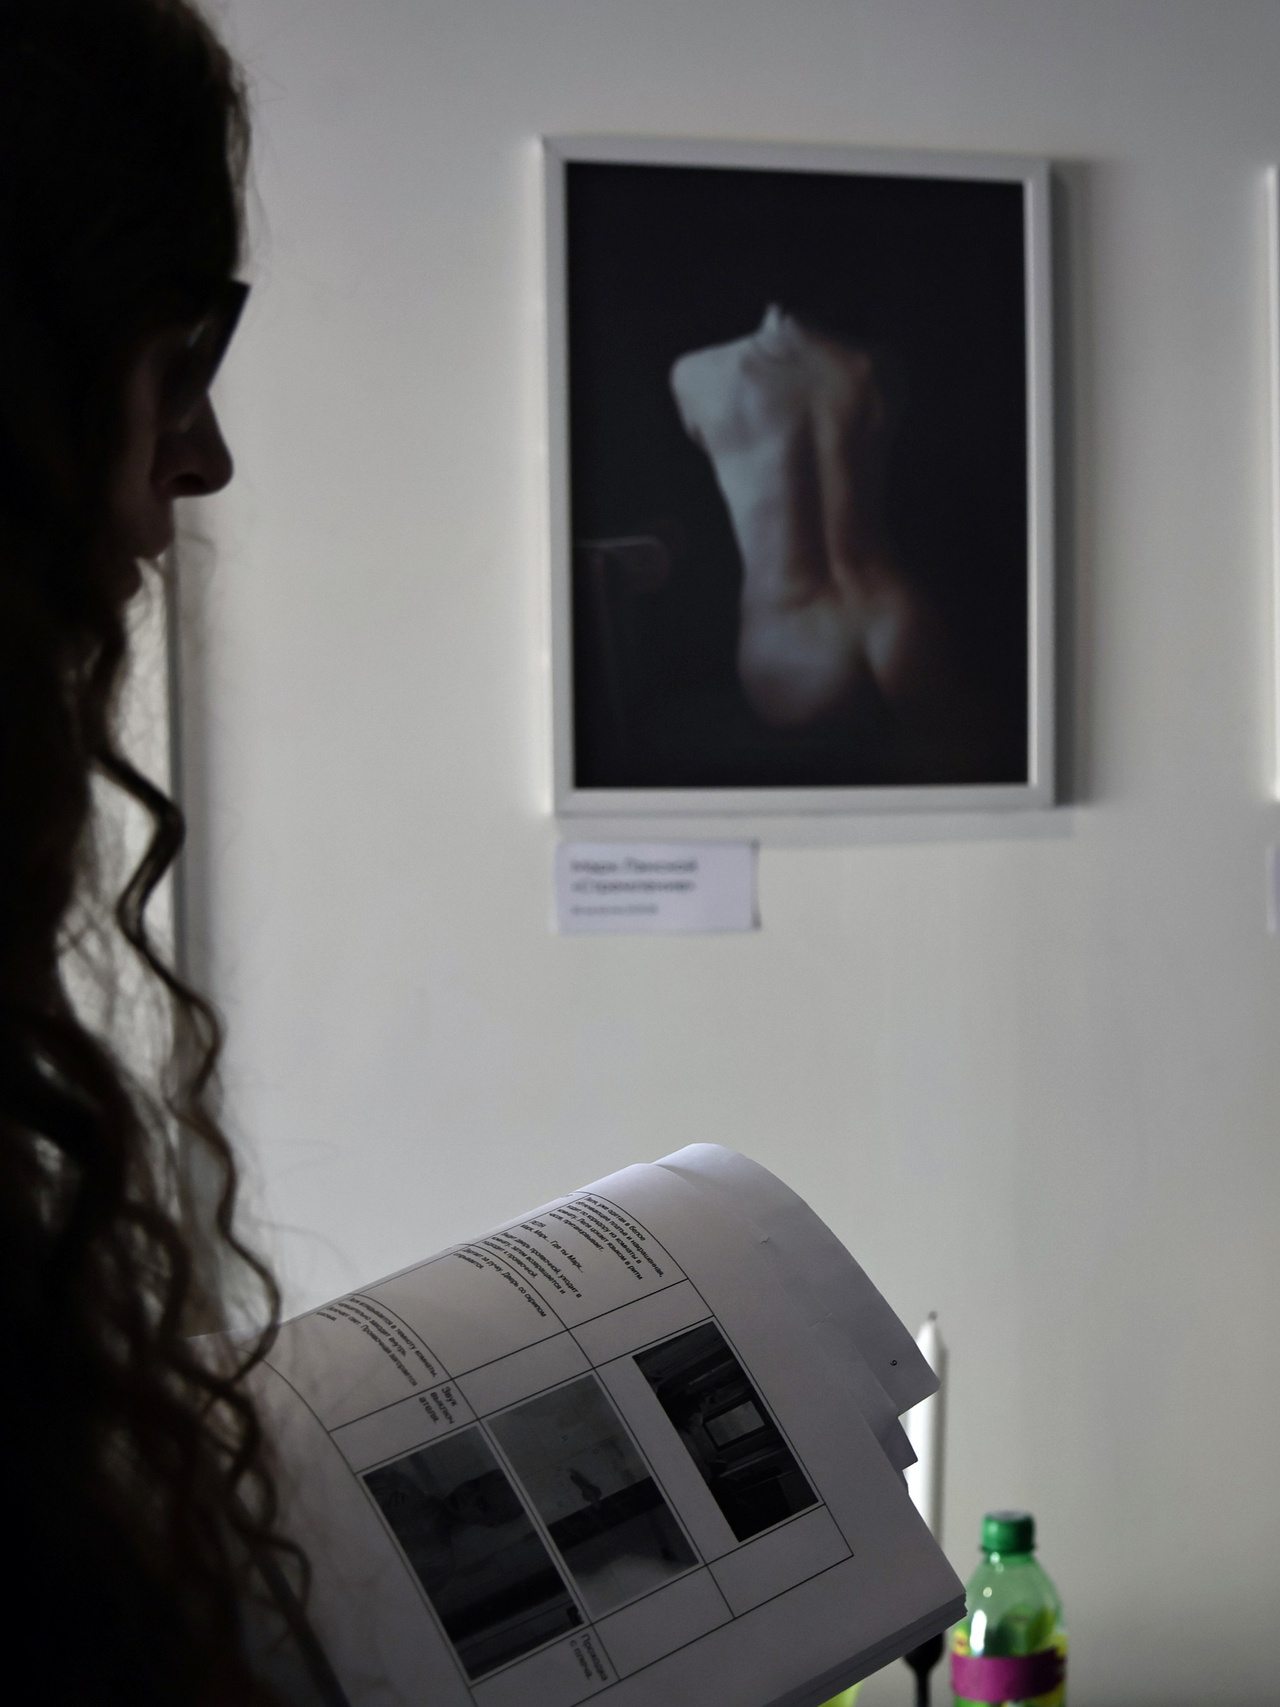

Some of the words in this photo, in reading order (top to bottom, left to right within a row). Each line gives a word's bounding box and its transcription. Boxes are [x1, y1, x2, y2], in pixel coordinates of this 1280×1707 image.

[563, 1219, 604, 1252] пританцовывает.
[587, 1215, 610, 1232] коридору
[615, 1238, 638, 1260] комнаты
[608, 1210, 626, 1223] одетая
[629, 1226, 646, 1241] белое
[550, 1240, 561, 1249] Где
[567, 1254, 584, 1273] Марк...
[590, 1228, 609, 1242] цокает
[607, 1242, 627, 1261] языком
[627, 1265, 643, 1280] ритм
[609, 1220, 628, 1237] платье
[630, 1240, 664, 1278] накрашенная,
[525, 1256, 561, 1290] возвращается
[558, 1274, 579, 1293] уходит
[501, 1271, 519, 1287] Дверь
[518, 1286, 527, 1294] со
[525, 1293, 547, 1318] скрипом
[390, 1353, 418, 1386] загорается
[395, 1328, 418, 1350] темноту
[415, 1350, 438, 1378] комнаты.
[419, 1396, 440, 1424] ателя.
[430, 1391, 455, 1425] выключ
[442, 1386, 457, 1406] Звук
[574, 1647, 593, 1680] плеча.
[581, 1633, 608, 1681] Проходка
